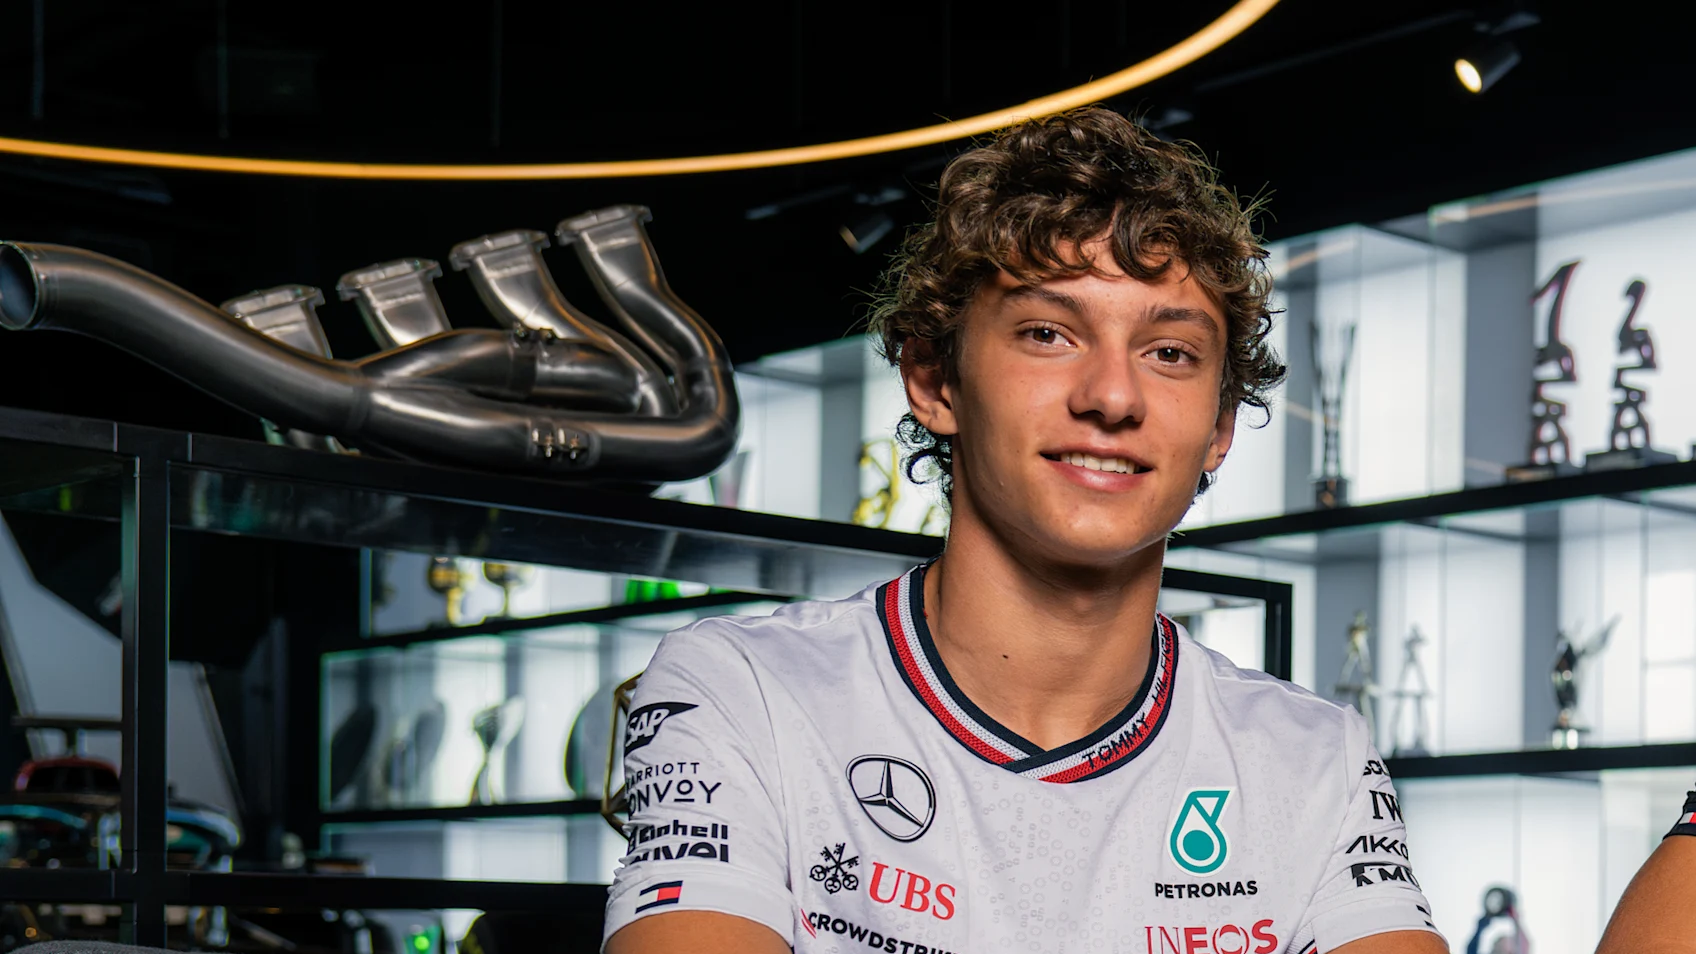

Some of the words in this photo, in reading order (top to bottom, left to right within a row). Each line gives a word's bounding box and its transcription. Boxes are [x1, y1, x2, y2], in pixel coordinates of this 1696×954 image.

[1082, 712, 1149, 769] TOMMY
[628, 779, 722, 820] ONVOY
[1369, 789, 1404, 824] IW
[1345, 835, 1409, 861] AKKO
[868, 861, 956, 921] UBS
[1155, 880, 1258, 899] PETRONAS
